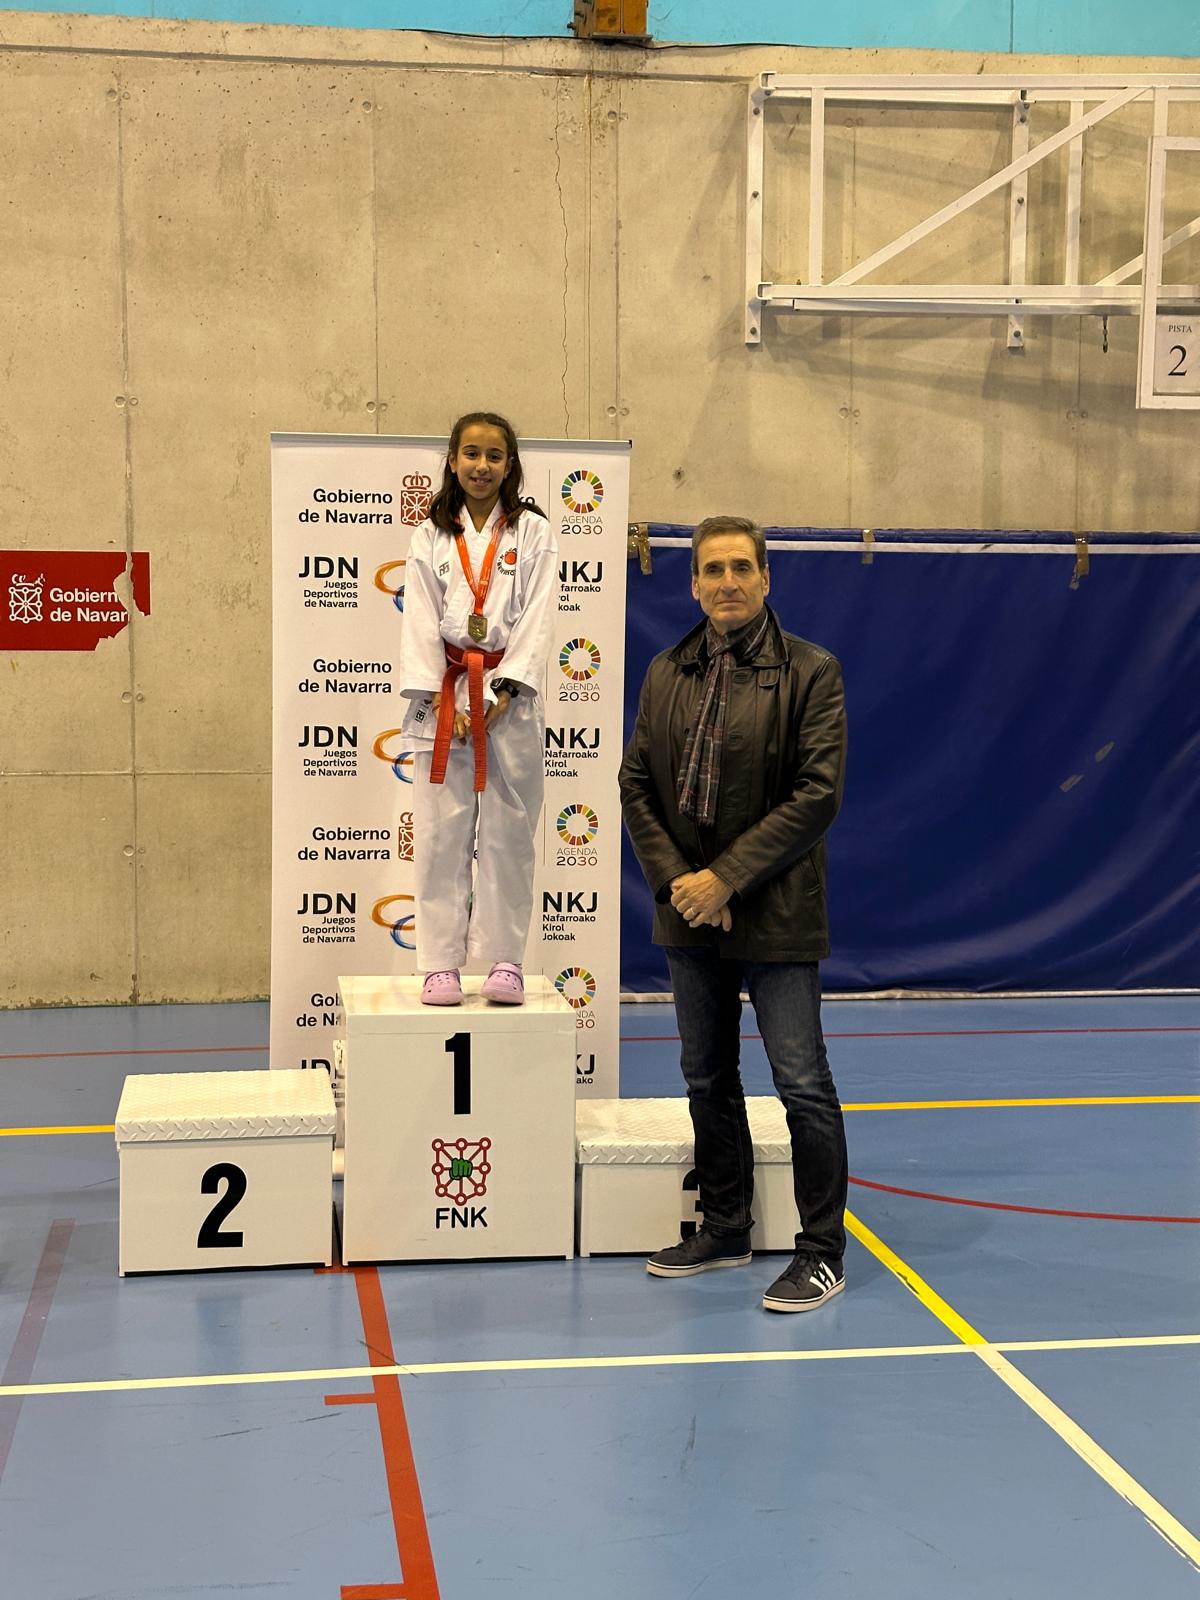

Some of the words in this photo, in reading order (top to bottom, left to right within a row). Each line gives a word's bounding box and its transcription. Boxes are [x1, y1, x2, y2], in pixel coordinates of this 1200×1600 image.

[1168, 345, 1187, 376] 2
[313, 489, 392, 504] Gobierno
[299, 509, 319, 522] de
[326, 509, 392, 524] Navarra
[562, 515, 603, 524] AGENDA
[561, 524, 602, 534] 2030
[299, 556, 358, 578] JDN
[324, 580, 358, 590] Juegos
[561, 584, 601, 592] farroako
[50, 588, 118, 602] Gobiern
[304, 590, 358, 599] Deportivos
[304, 599, 317, 608] de
[319, 600, 358, 608] Navarra
[558, 603, 580, 611] koak
[50, 608, 71, 621] de
[77, 608, 127, 622] Navar
[313, 659, 391, 673] Gobierno
[299, 679, 319, 692] de
[326, 679, 391, 693] Navarra
[559, 683, 600, 691] AGENDA
[559, 692, 599, 701] 2030
[299, 726, 357, 747] JDN
[545, 728, 600, 749] NKJ
[323, 749, 357, 758] Juegos
[545, 750, 598, 758] Nafarroako
[303, 759, 357, 768] Deportivos
[304, 768, 317, 776] de
[545, 769, 578, 777] Jokoak
[313, 827, 390, 840] Gobierno
[298, 847, 318, 860] de
[325, 847, 390, 860] Navarra
[557, 856, 597, 866] 2030
[297, 893, 355, 914] JDN
[543, 892, 597, 912] NKJ
[322, 916, 356, 926] Juegos
[543, 914, 595, 922] Nafarroako
[302, 925, 355, 935] Deportivos
[302, 935, 315, 943] de
[577, 1010, 595, 1018] NDA
[297, 1014, 317, 1027] de
[576, 1019, 595, 1028] 30
[445, 1032, 471, 1115] 1
[197, 1163, 247, 1248] 2
[436, 1207, 487, 1229] FNK
